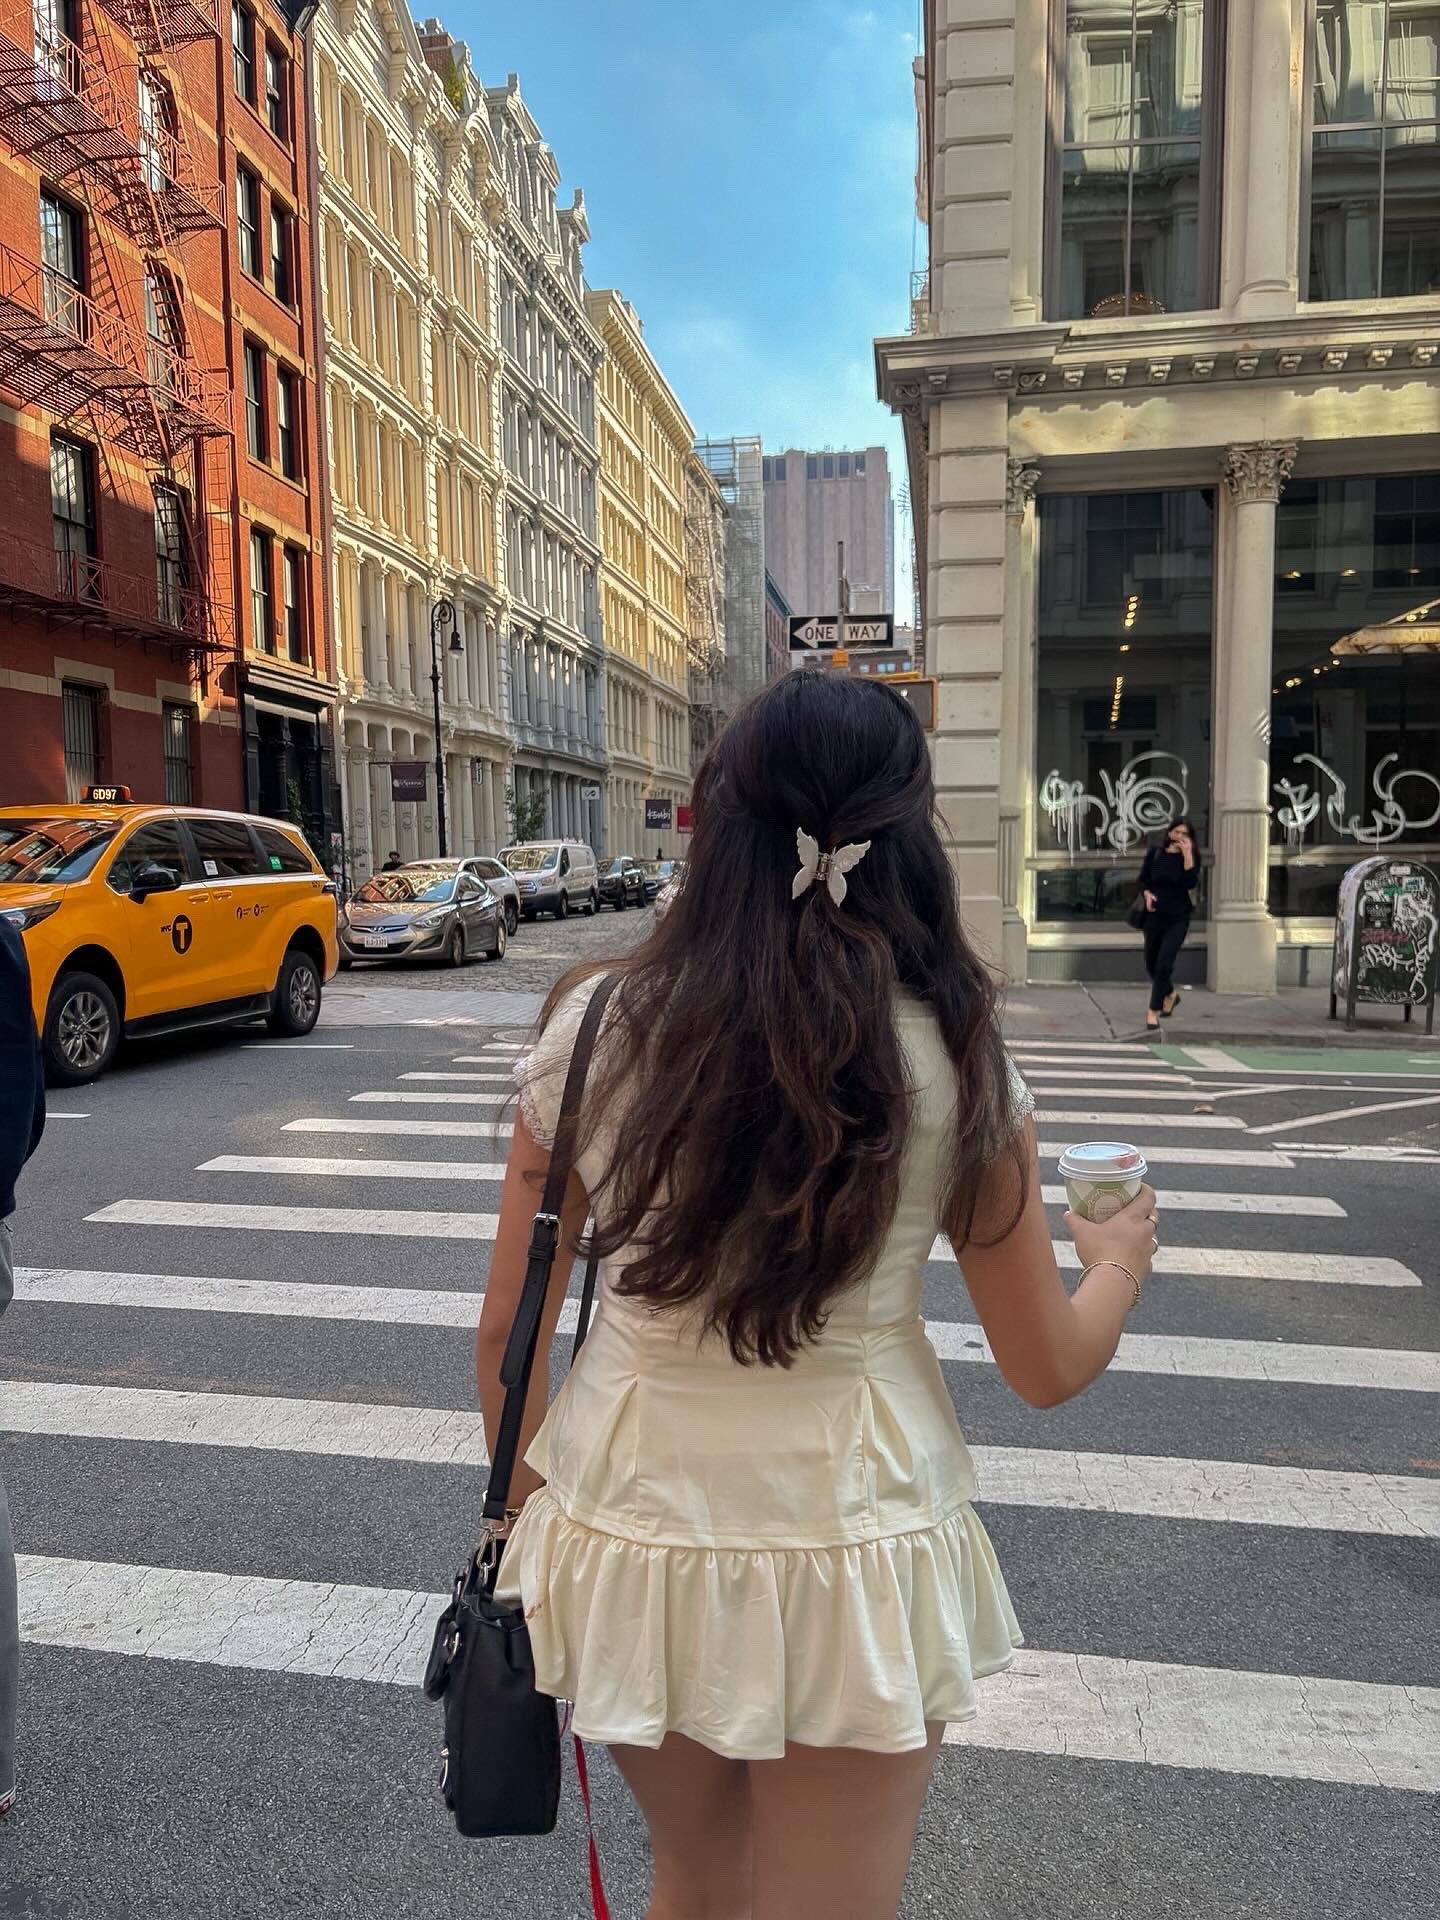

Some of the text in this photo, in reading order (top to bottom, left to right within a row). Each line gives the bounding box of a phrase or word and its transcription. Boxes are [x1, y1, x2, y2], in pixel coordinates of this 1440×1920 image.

[804, 624, 881, 640] ONE WAY
[92, 788, 117, 800] 6D97
